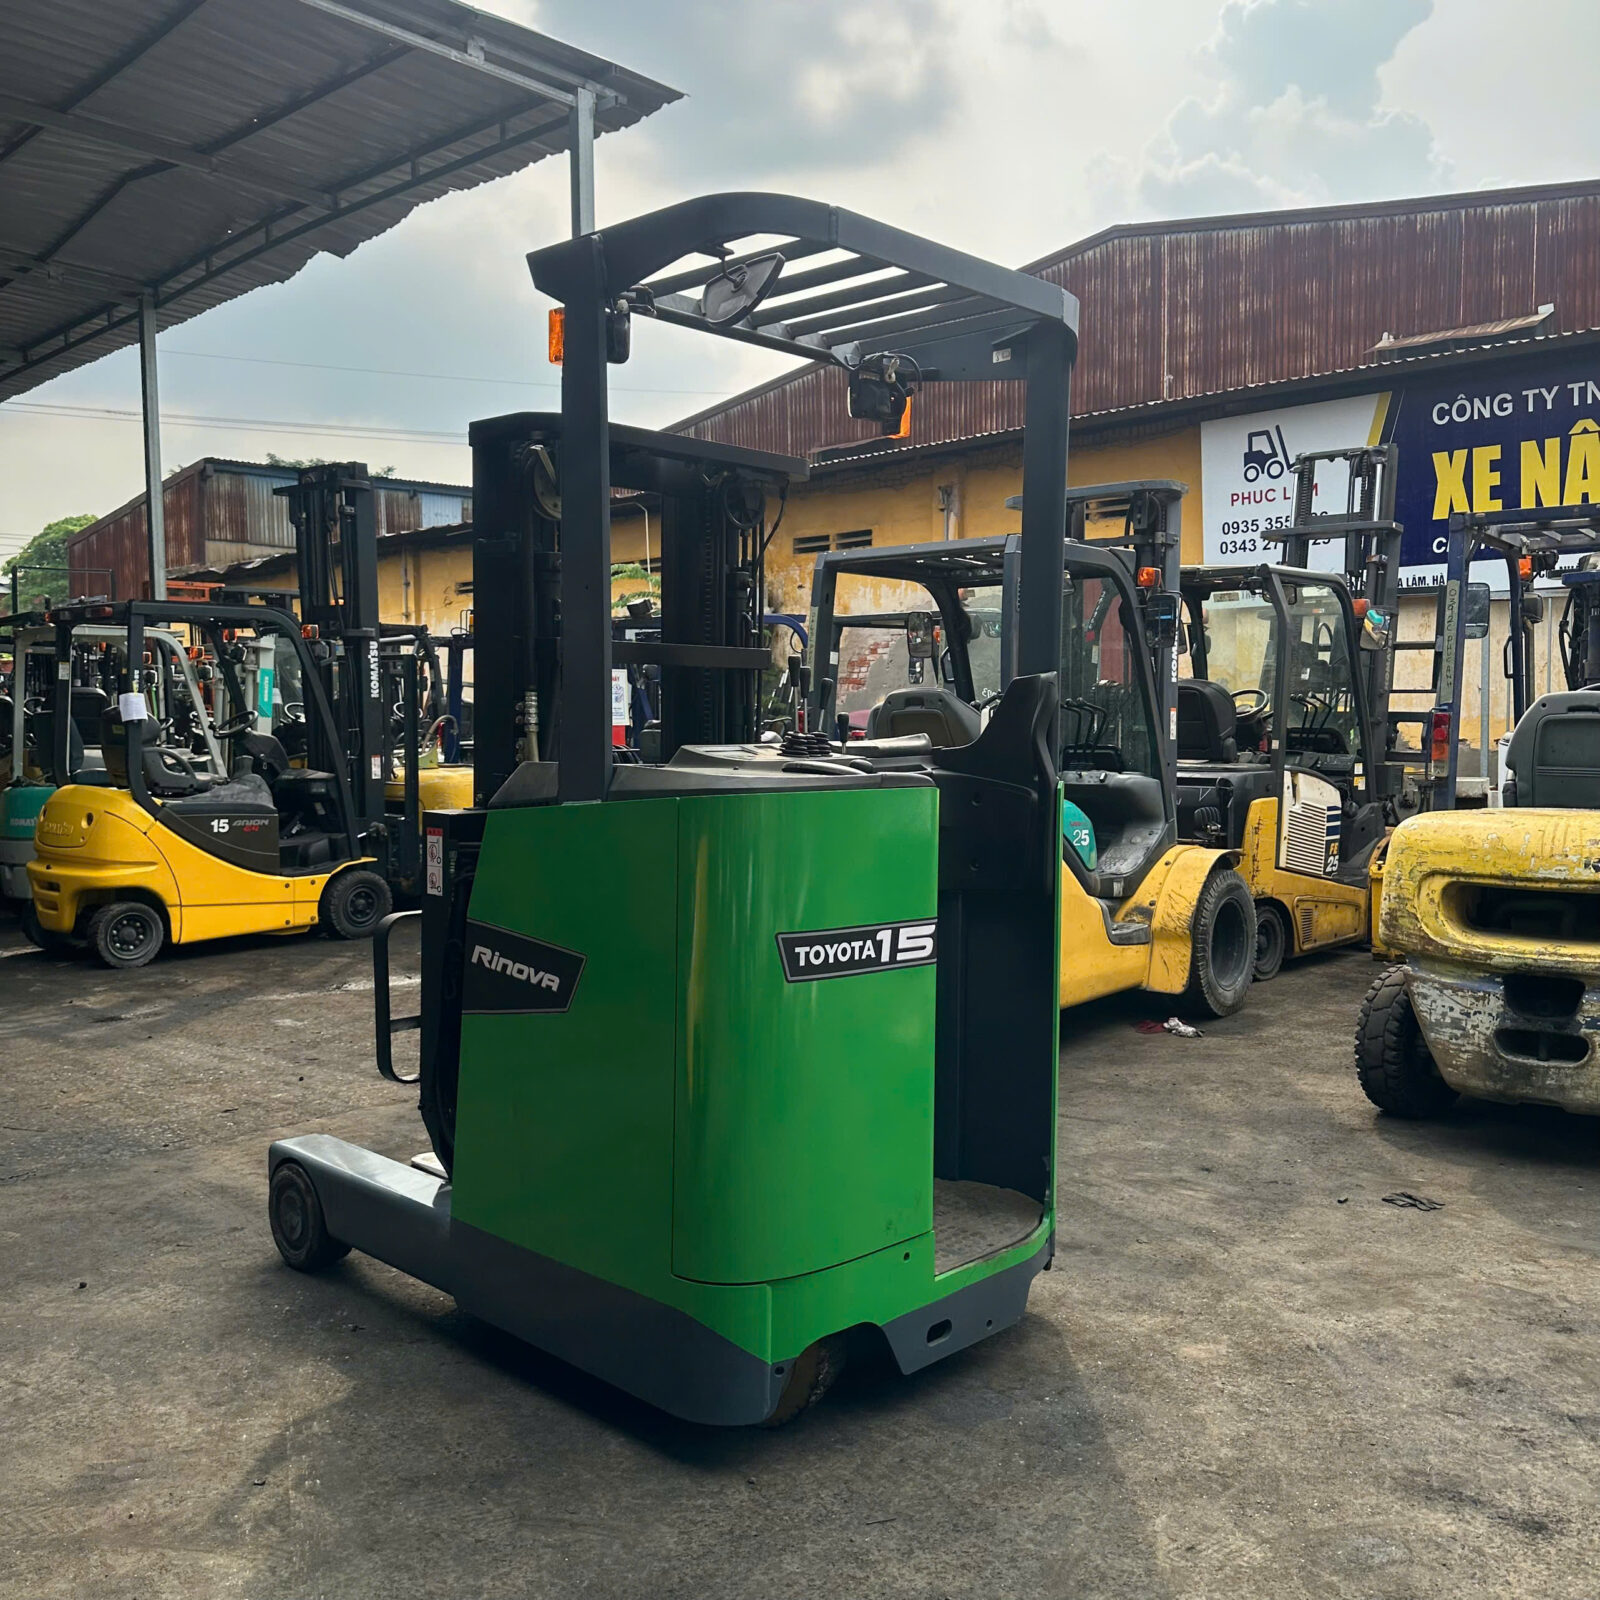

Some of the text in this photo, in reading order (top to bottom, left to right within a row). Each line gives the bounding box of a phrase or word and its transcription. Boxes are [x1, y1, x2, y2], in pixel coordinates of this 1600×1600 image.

[1432, 393, 1513, 425] CÔNG
[1522, 385, 1559, 413] TY
[1432, 418, 1600, 520] XE NÂ
[1222, 519, 1259, 535] 0935
[1220, 539, 1257, 555] 0343
[368, 640, 379, 698] KOMATSU
[210, 818, 230, 833] 15
[1073, 829, 1090, 846] 25
[1325, 854, 1340, 872] 25
[794, 924, 936, 967] TOYOTA 15
